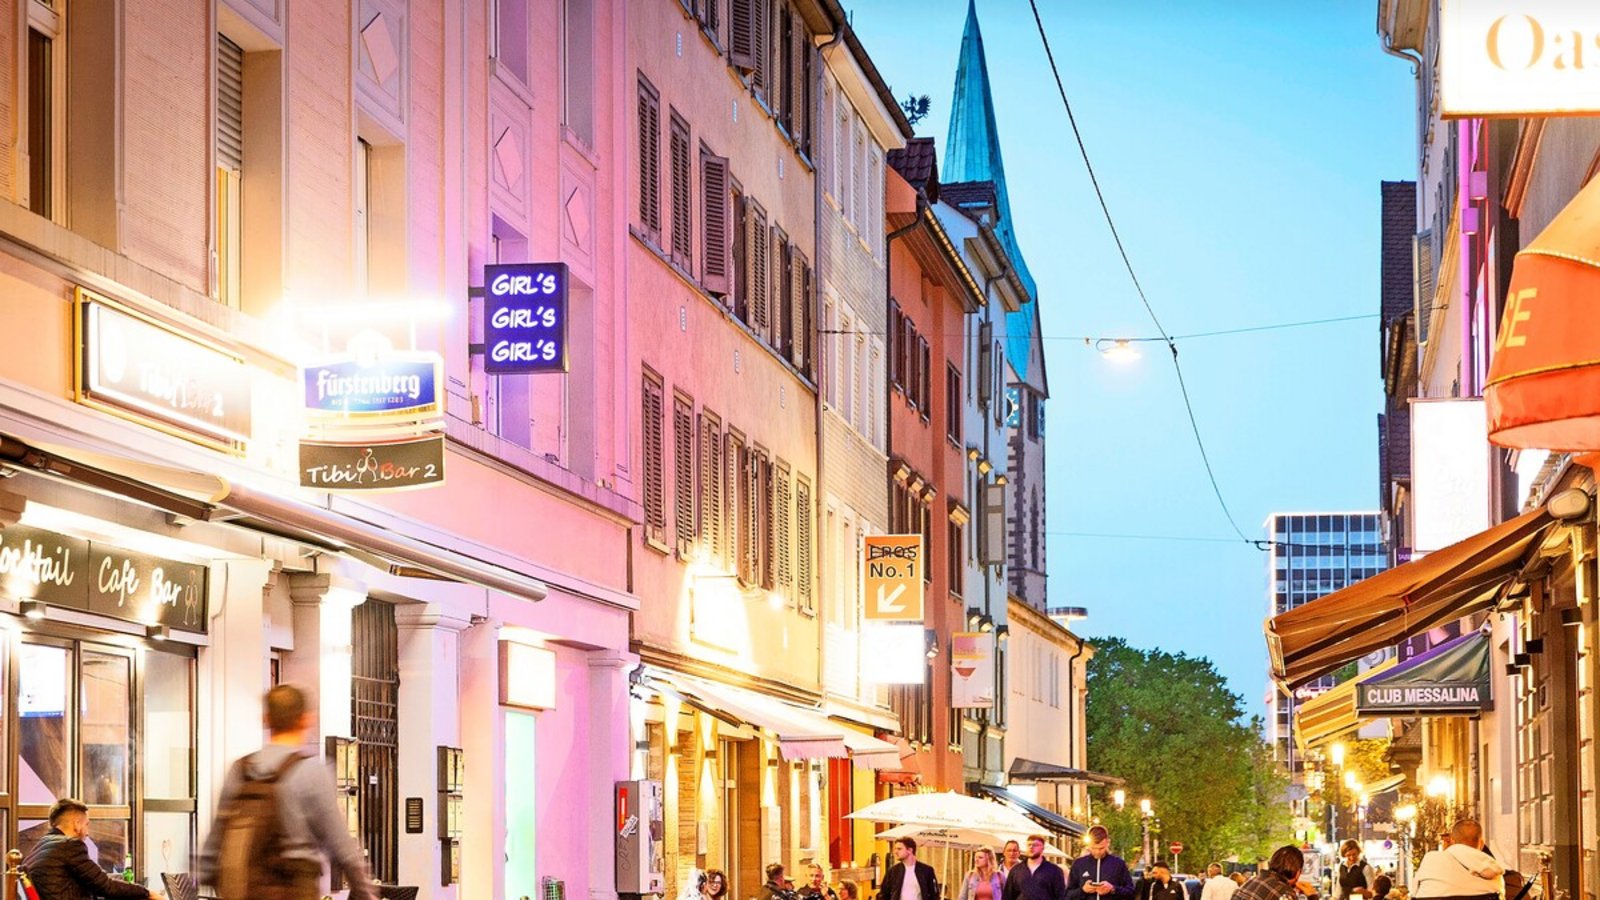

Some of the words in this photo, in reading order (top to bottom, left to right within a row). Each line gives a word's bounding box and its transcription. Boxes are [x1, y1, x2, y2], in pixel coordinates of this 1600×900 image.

[1486, 13, 1600, 71] Oa
[491, 273, 556, 296] GIRL'S
[491, 306, 556, 329] GIRL'S
[491, 339, 556, 362] GIRL'S
[306, 464, 357, 483] Tibi
[380, 461, 420, 480] Bar
[424, 463, 437, 478] 2
[0, 534, 74, 586] ocktail
[151, 567, 182, 606] Bar
[1367, 688, 1402, 703] CLUB
[1404, 687, 1479, 702] MESSALINA
